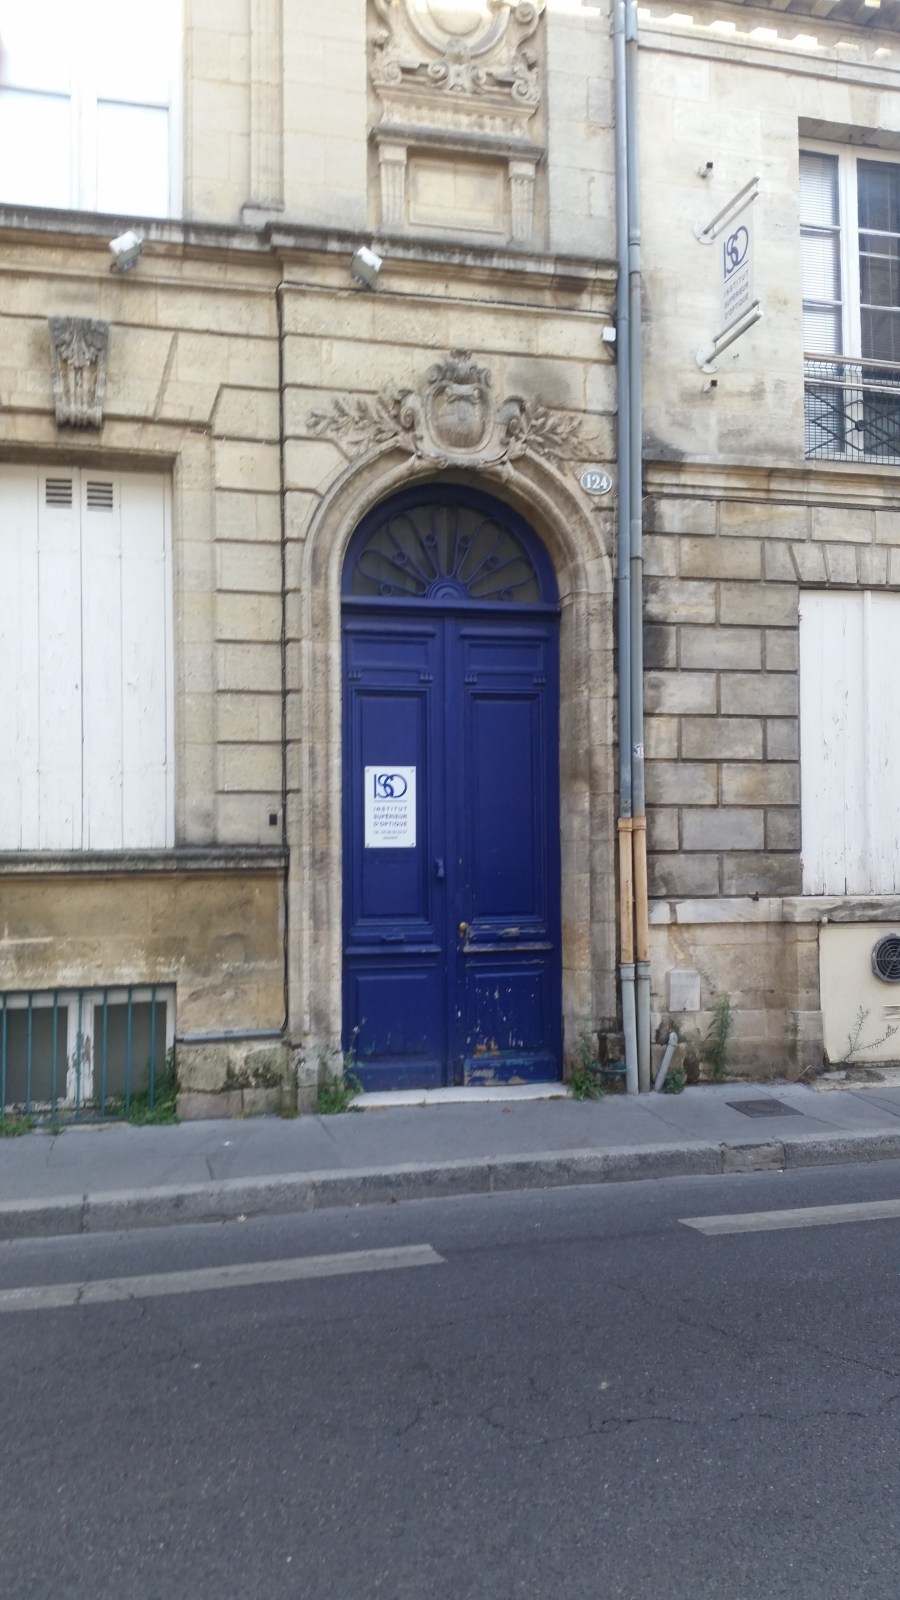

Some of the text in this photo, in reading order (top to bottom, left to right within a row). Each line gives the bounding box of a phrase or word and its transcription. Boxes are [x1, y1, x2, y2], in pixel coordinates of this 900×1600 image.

[723, 225, 749, 279] ISO
[724, 269, 749, 297] INSTITUT
[586, 474, 608, 489] 124
[374, 774, 408, 798] ISO
